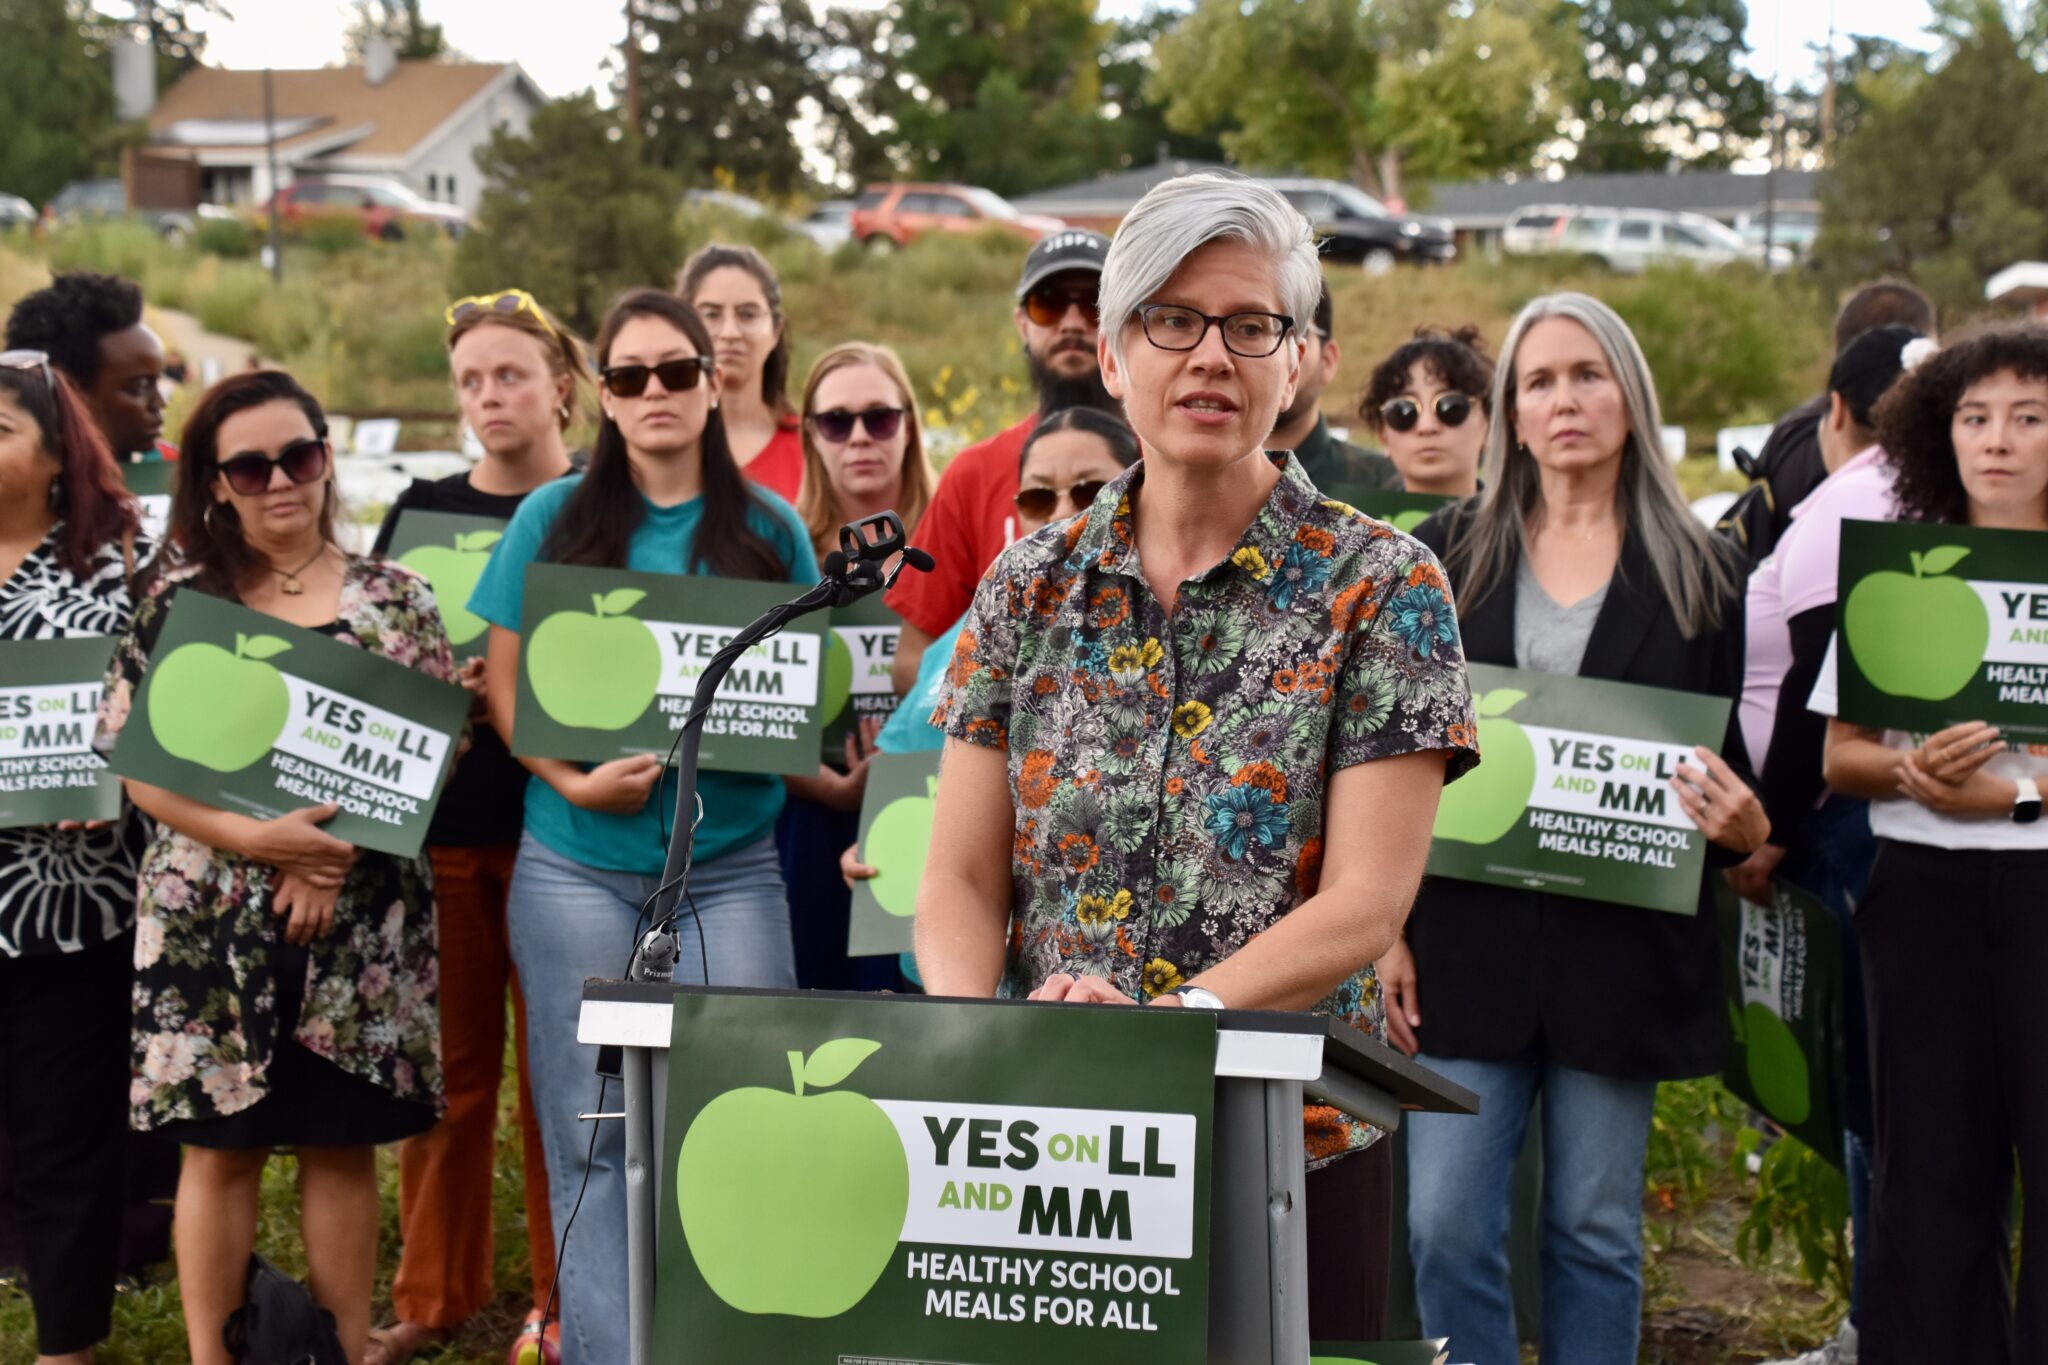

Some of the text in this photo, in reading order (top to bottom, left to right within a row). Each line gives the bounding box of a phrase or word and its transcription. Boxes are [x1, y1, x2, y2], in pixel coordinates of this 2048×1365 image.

[2001, 592, 2048, 620] YE
[772, 640, 808, 665] LL
[859, 634, 898, 657] YE
[2010, 627, 2048, 644] AN
[678, 664, 784, 695] AN MM
[868, 663, 893, 677] AN
[37, 698, 65, 712] ON
[659, 698, 809, 723] HEAHY SCHOOL
[853, 696, 899, 711] HEALT
[22, 722, 83, 749] MM
[305, 690, 433, 762] YES ON LL
[669, 716, 797, 740] MALS FOR ALL
[301, 726, 403, 784] AND MM
[1548, 737, 1616, 772] YES
[1619, 754, 1651, 772] ON
[29, 773, 64, 790] FOR
[66, 771, 98, 786] ALL
[271, 752, 420, 815] HEALTHY SCHOOL
[1552, 774, 1667, 817] AND MM
[275, 775, 335, 806] MEALS
[335, 795, 370, 817] FOR
[372, 808, 404, 826] ALL
[1529, 811, 1691, 850] HEALTHY SCHOOL
[1538, 833, 1677, 869] MEALS FOR ALL
[1743, 932, 1760, 988] YES
[922, 1115, 1176, 1178] YES ON LL
[937, 1181, 1132, 1241] AND MM
[907, 1251, 1180, 1296] HEALTHY SCHOOL
[925, 1288, 1158, 1331] MEALS FOR ALL
